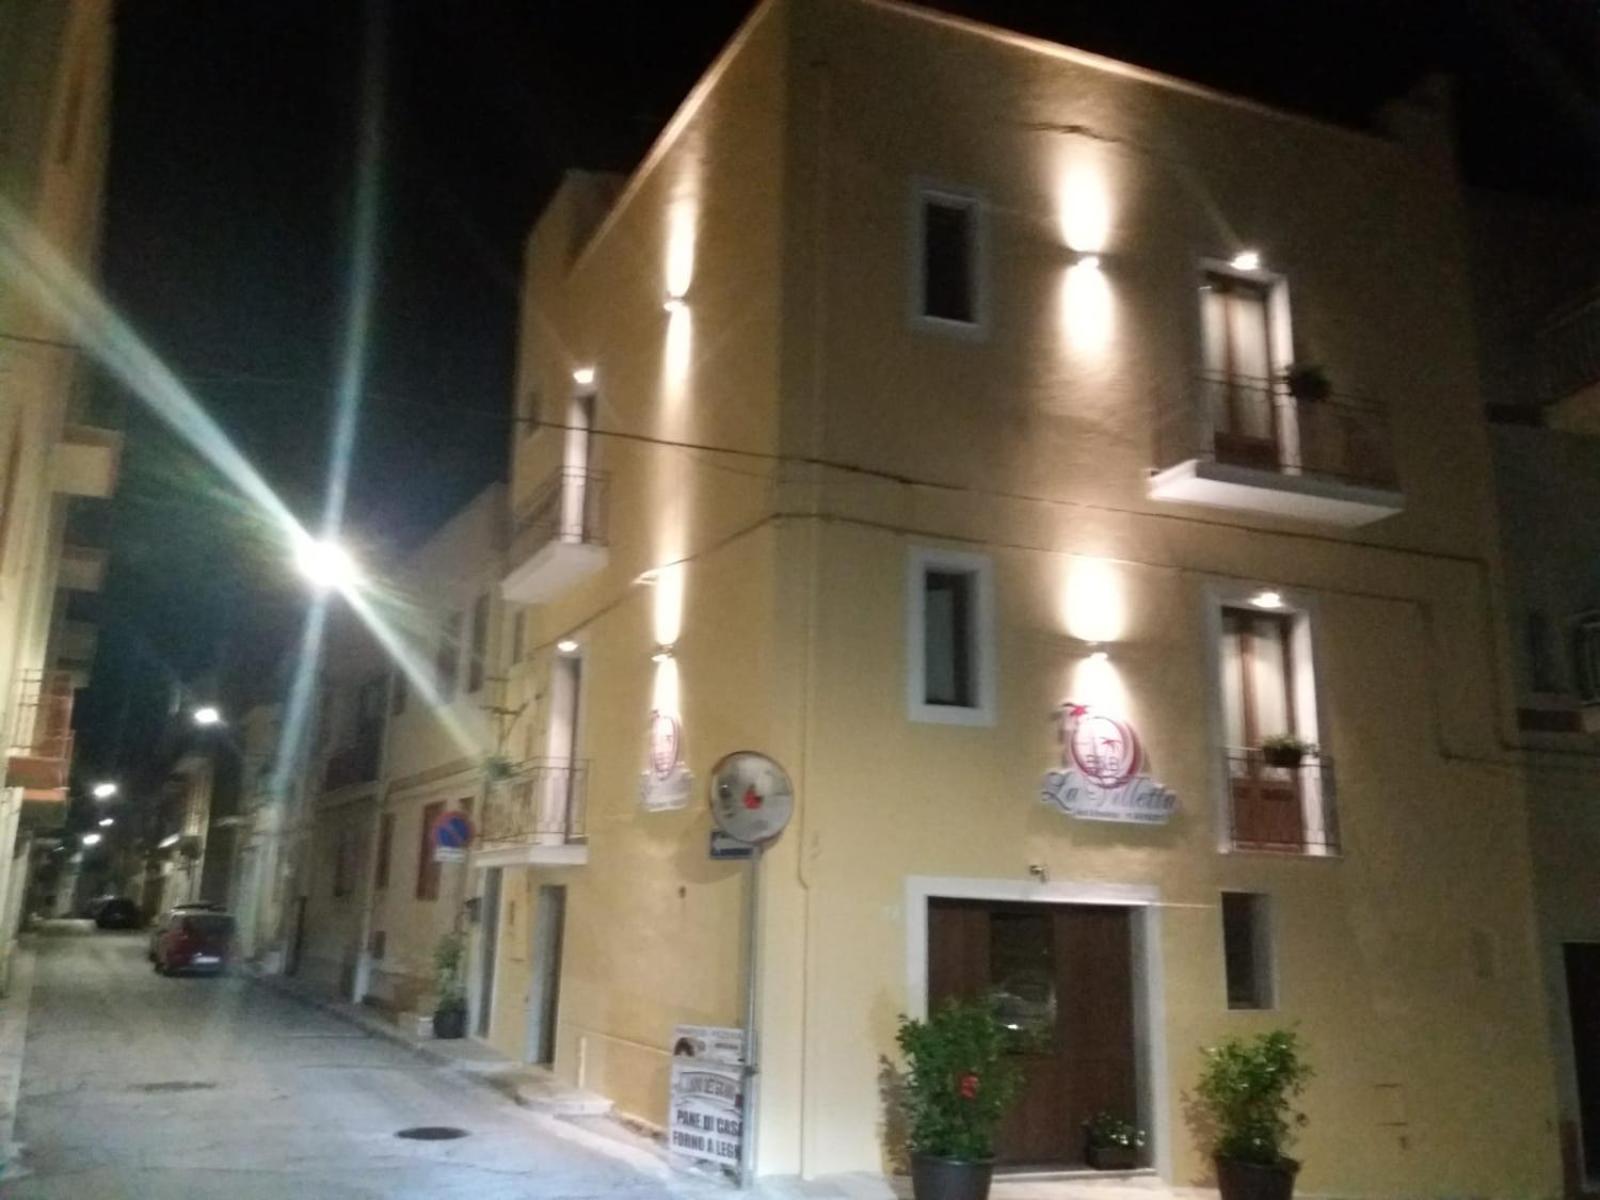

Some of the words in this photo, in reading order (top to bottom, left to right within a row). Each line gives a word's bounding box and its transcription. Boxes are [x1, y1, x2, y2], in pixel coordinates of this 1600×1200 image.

[677, 1109, 701, 1130] PANE
[703, 1115, 714, 1131] DI
[672, 1130, 704, 1152] FORNO
[707, 1137, 714, 1153] A
[715, 1140, 743, 1161] LEGN
